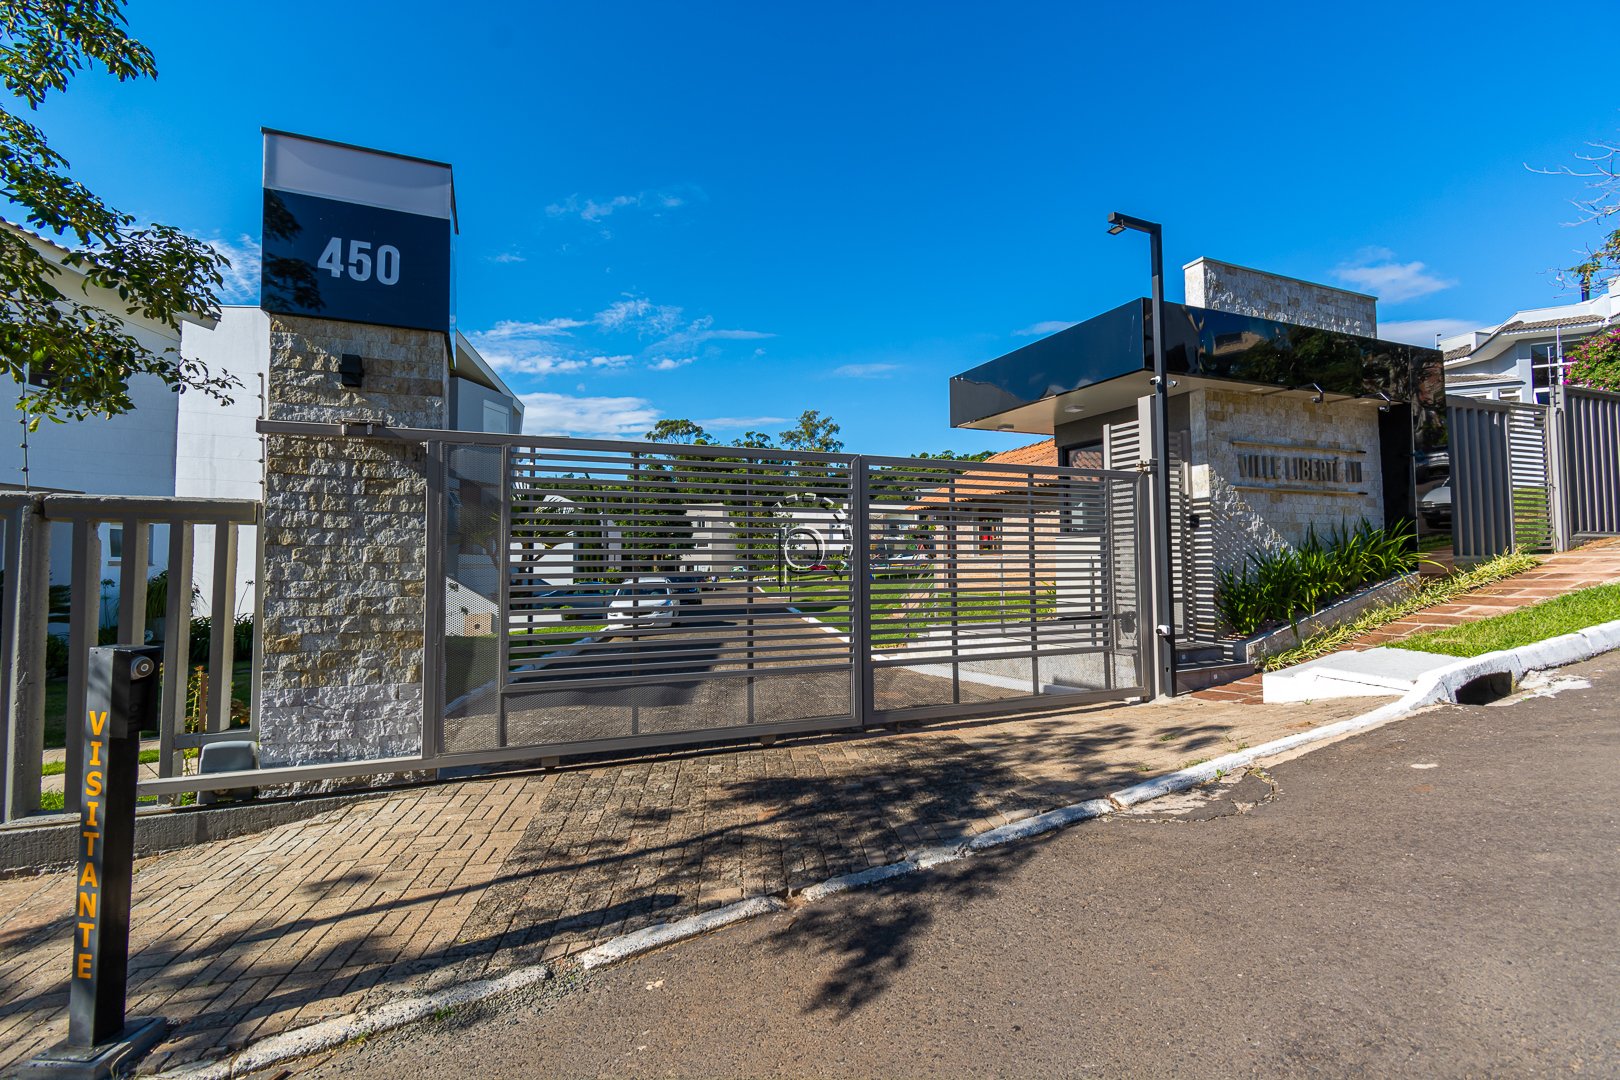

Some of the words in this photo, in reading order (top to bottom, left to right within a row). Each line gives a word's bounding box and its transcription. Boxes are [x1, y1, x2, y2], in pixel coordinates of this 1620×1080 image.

[317, 236, 400, 286] 450
[1237, 454, 1282, 480] VILLE
[1284, 456, 1345, 483] LIBERTÉ
[77, 709, 108, 980] VISITANTE
